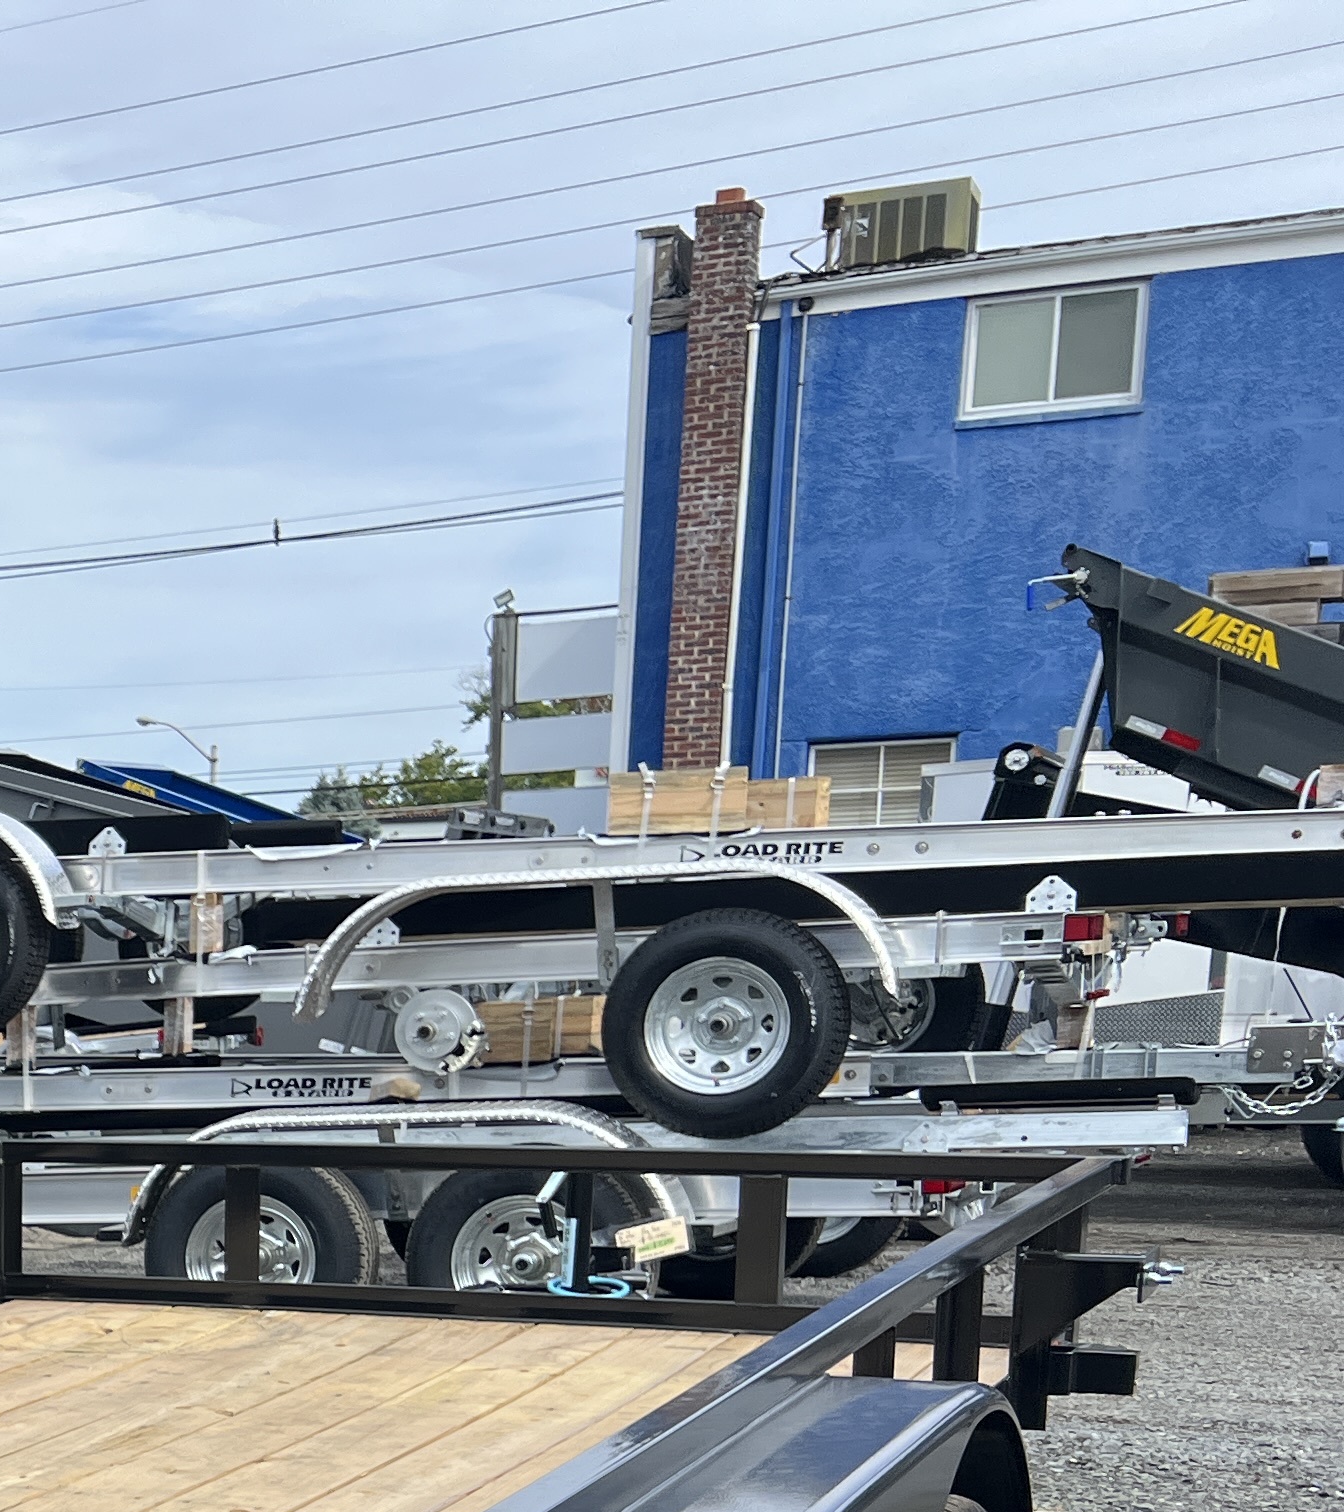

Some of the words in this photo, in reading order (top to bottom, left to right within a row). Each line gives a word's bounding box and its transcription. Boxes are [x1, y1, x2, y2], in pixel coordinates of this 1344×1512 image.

[1173, 606, 1281, 670] MEGA
[714, 842, 779, 858] OAD
[785, 841, 844, 855] RITE
[255, 1077, 316, 1090] LOAD
[322, 1077, 372, 1089] RITE
